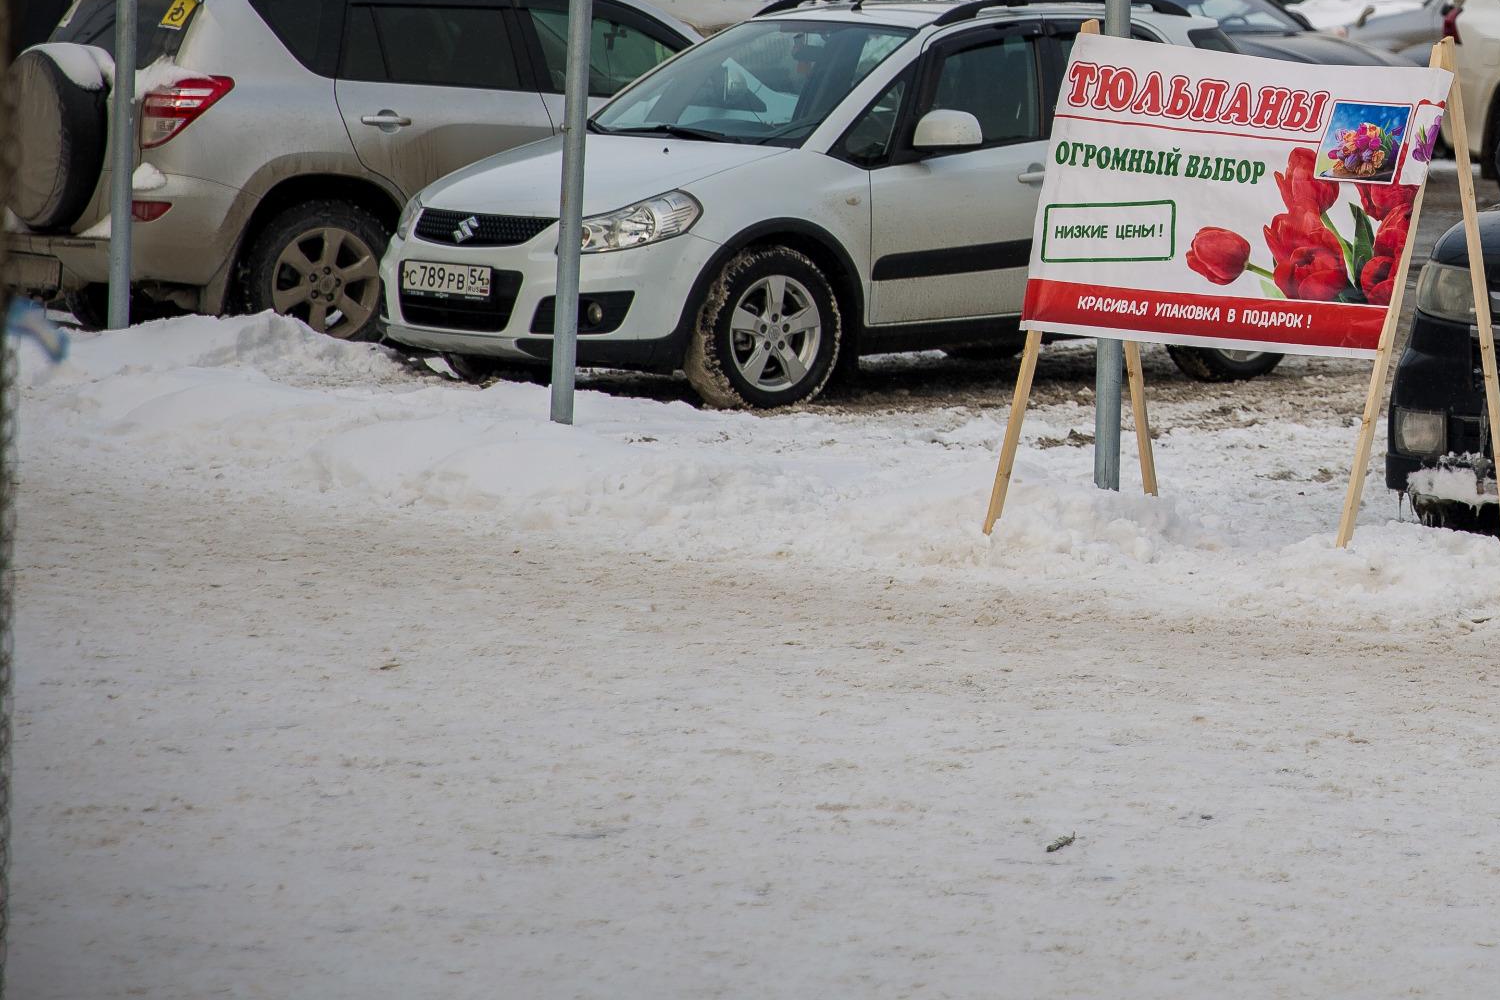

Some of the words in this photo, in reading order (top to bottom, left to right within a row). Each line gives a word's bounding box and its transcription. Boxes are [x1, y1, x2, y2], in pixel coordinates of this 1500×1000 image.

[1068, 61, 1331, 132] ТЮЛЬПАНЫ
[1055, 141, 1182, 176] ОГРОМНЫЙ
[1184, 154, 1266, 184] ВЫБОР
[1055, 224, 1108, 239] НИЗКИЕ
[469, 268, 486, 286] 54
[1077, 295, 1149, 316] КРАСИВАЯ
[1155, 302, 1220, 322] УПАКОВКА
[1227, 309, 1236, 322] В
